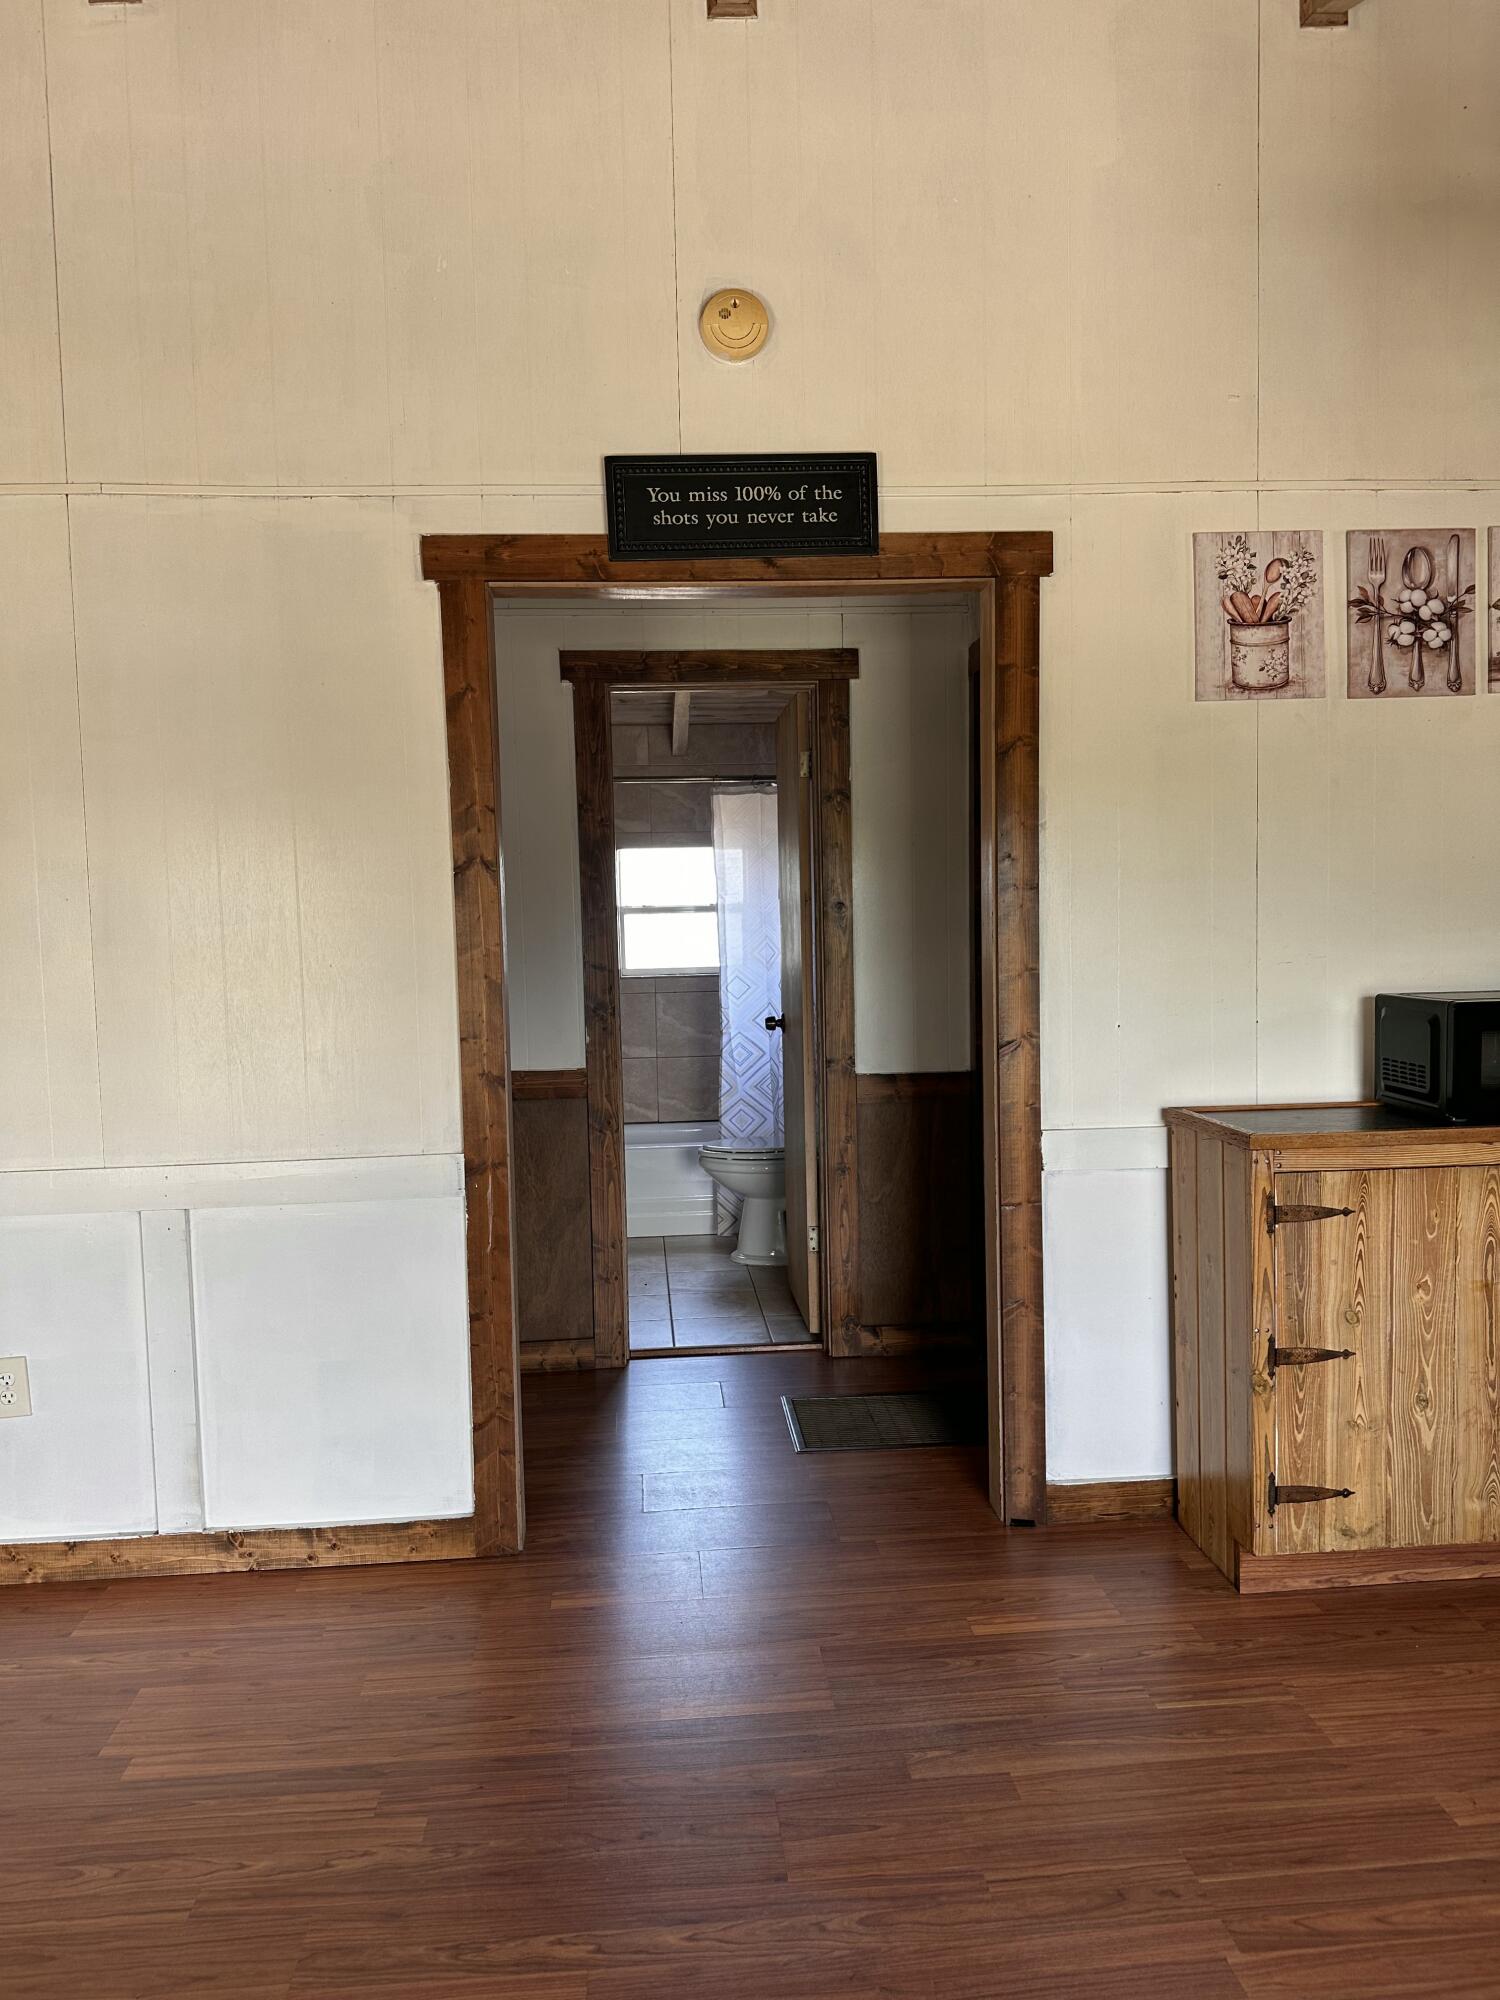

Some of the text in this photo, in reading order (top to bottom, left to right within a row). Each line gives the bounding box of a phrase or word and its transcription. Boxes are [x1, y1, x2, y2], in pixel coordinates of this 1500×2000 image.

[646, 484, 843, 503] You miss 100% of the
[653, 508, 838, 530] shots you never take
